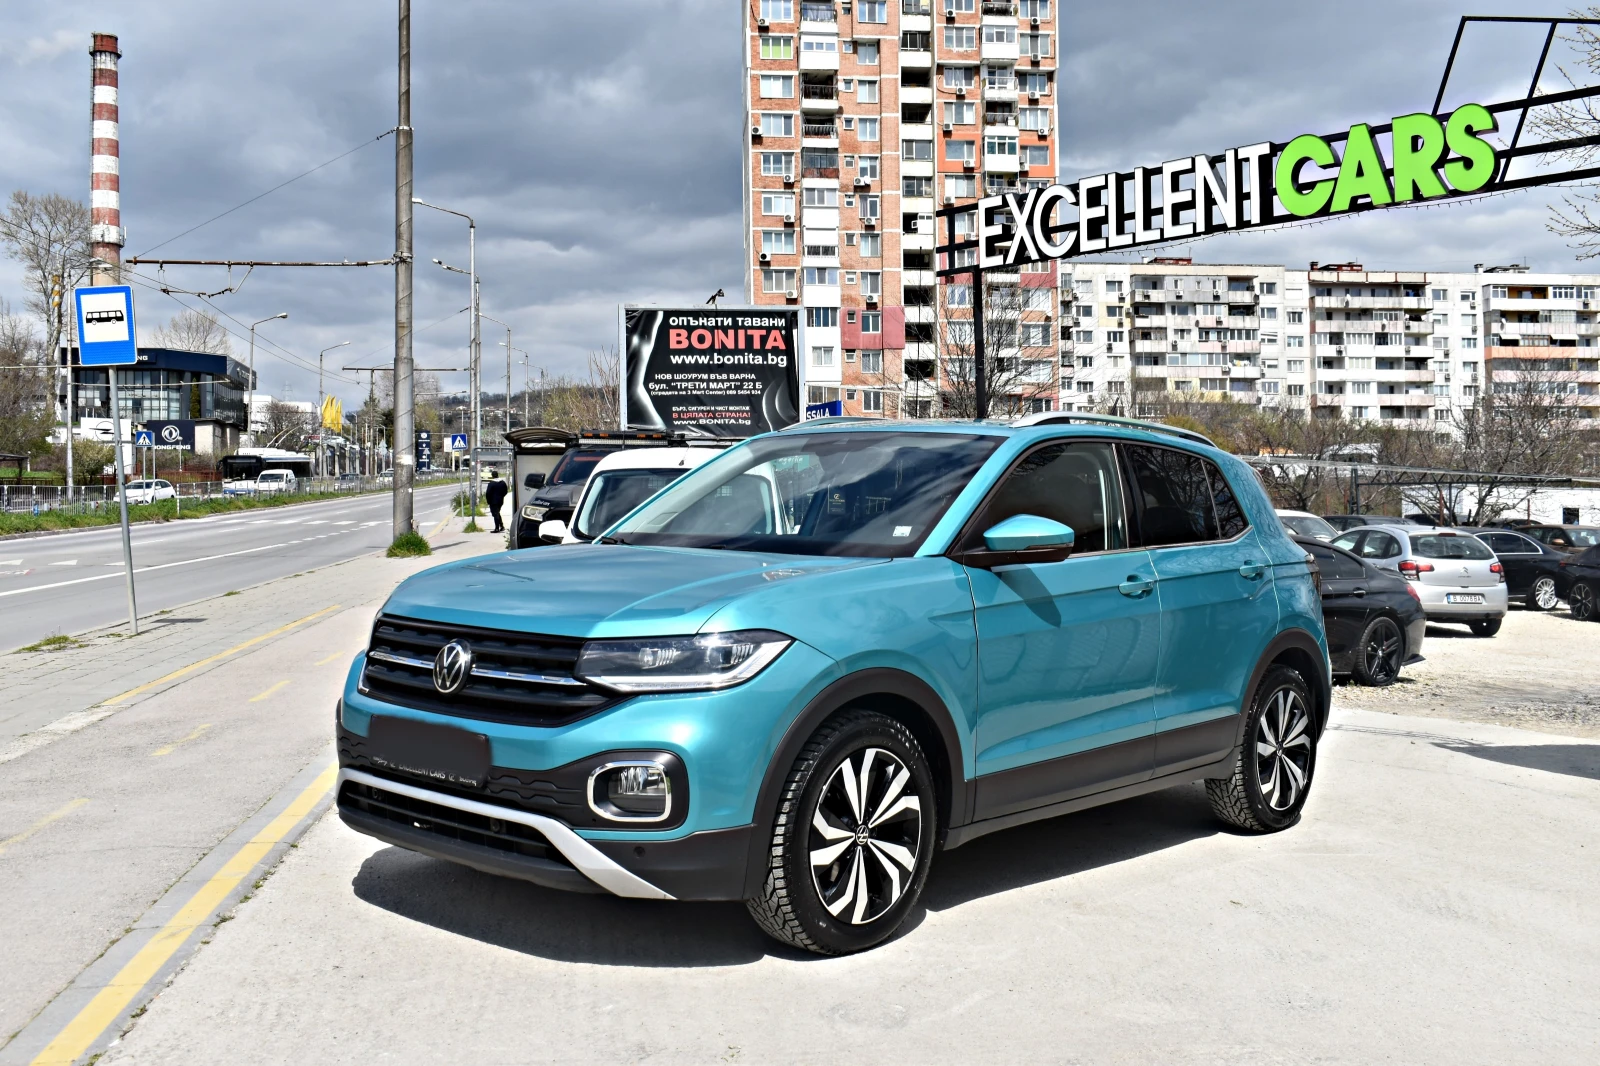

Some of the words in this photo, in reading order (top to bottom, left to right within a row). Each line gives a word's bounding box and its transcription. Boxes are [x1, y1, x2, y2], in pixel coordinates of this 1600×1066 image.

[978, 141, 1271, 269] EXCELLENT
[1275, 103, 1498, 217] CARS
[669, 316, 732, 326] опънати
[736, 317, 786, 327] тавани
[669, 328, 787, 350] BONITA
[670, 352, 788, 367] www.bonita.bg
[648, 382, 669, 390] бул.
